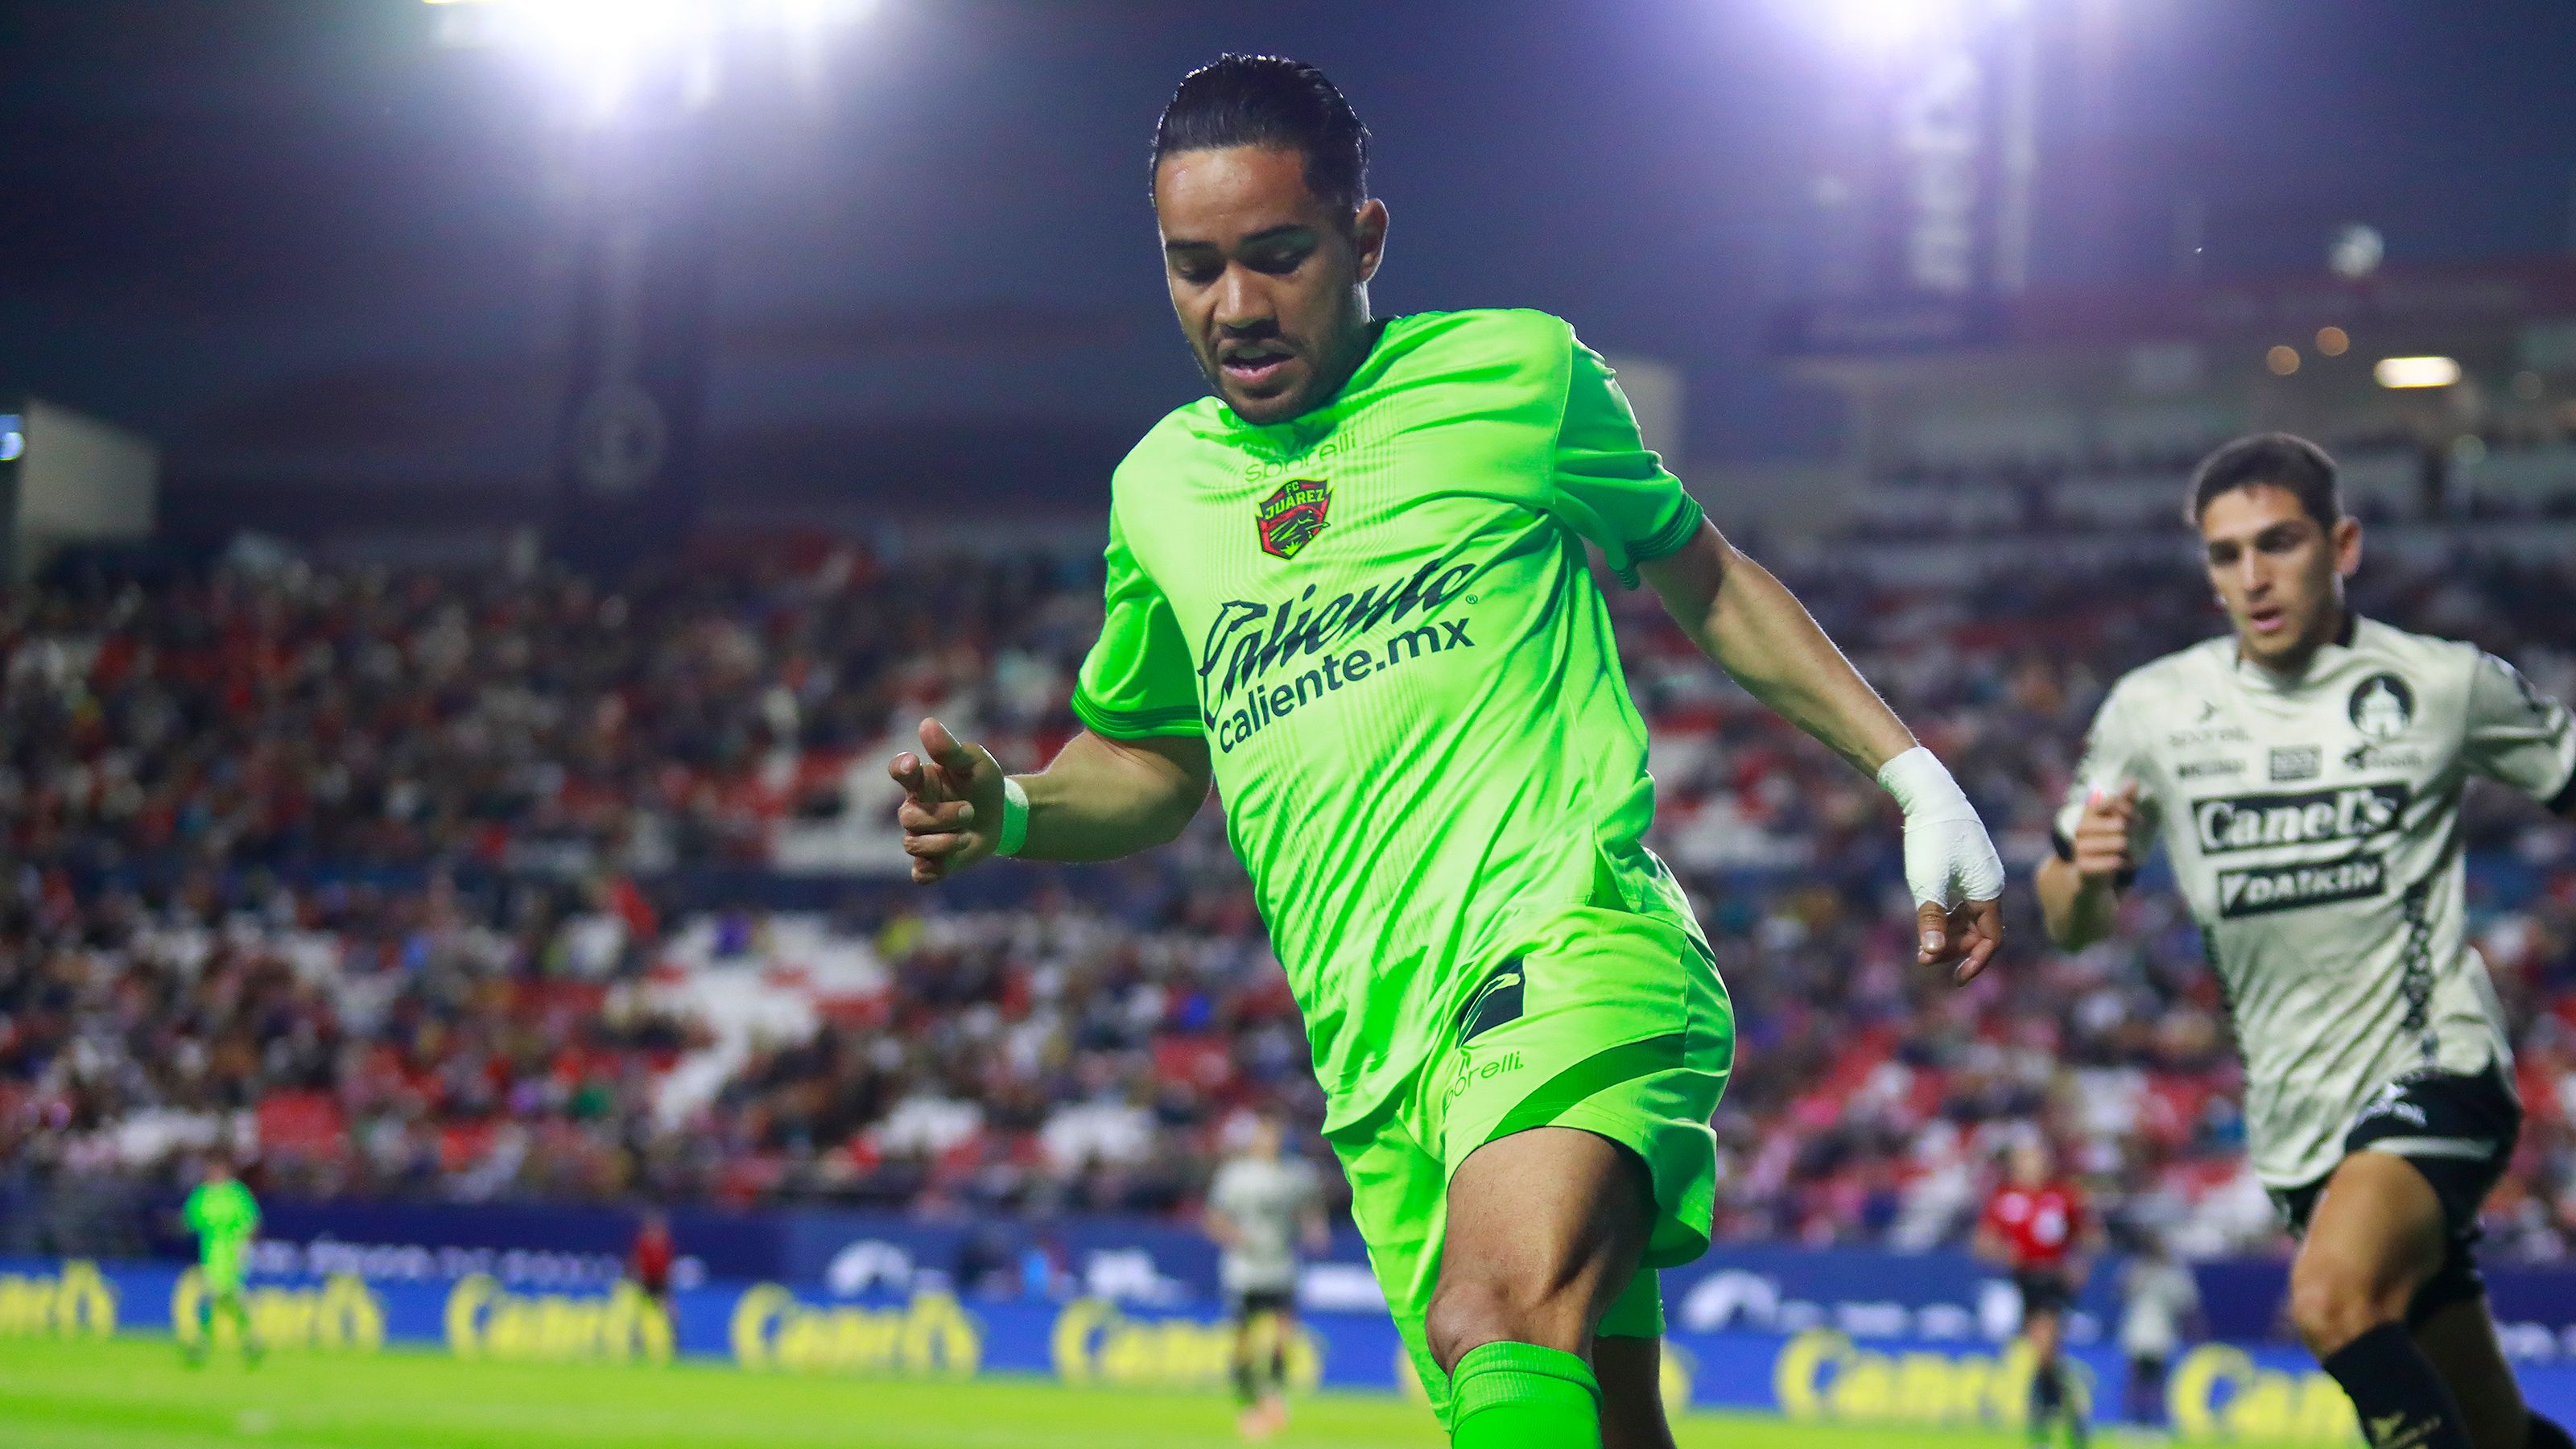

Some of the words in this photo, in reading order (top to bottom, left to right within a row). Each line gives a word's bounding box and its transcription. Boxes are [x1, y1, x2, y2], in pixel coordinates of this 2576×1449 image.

[1285, 481, 1300, 493] FC
[1197, 558, 1476, 731] Caliente
[1219, 617, 1475, 754] caliente.mx
